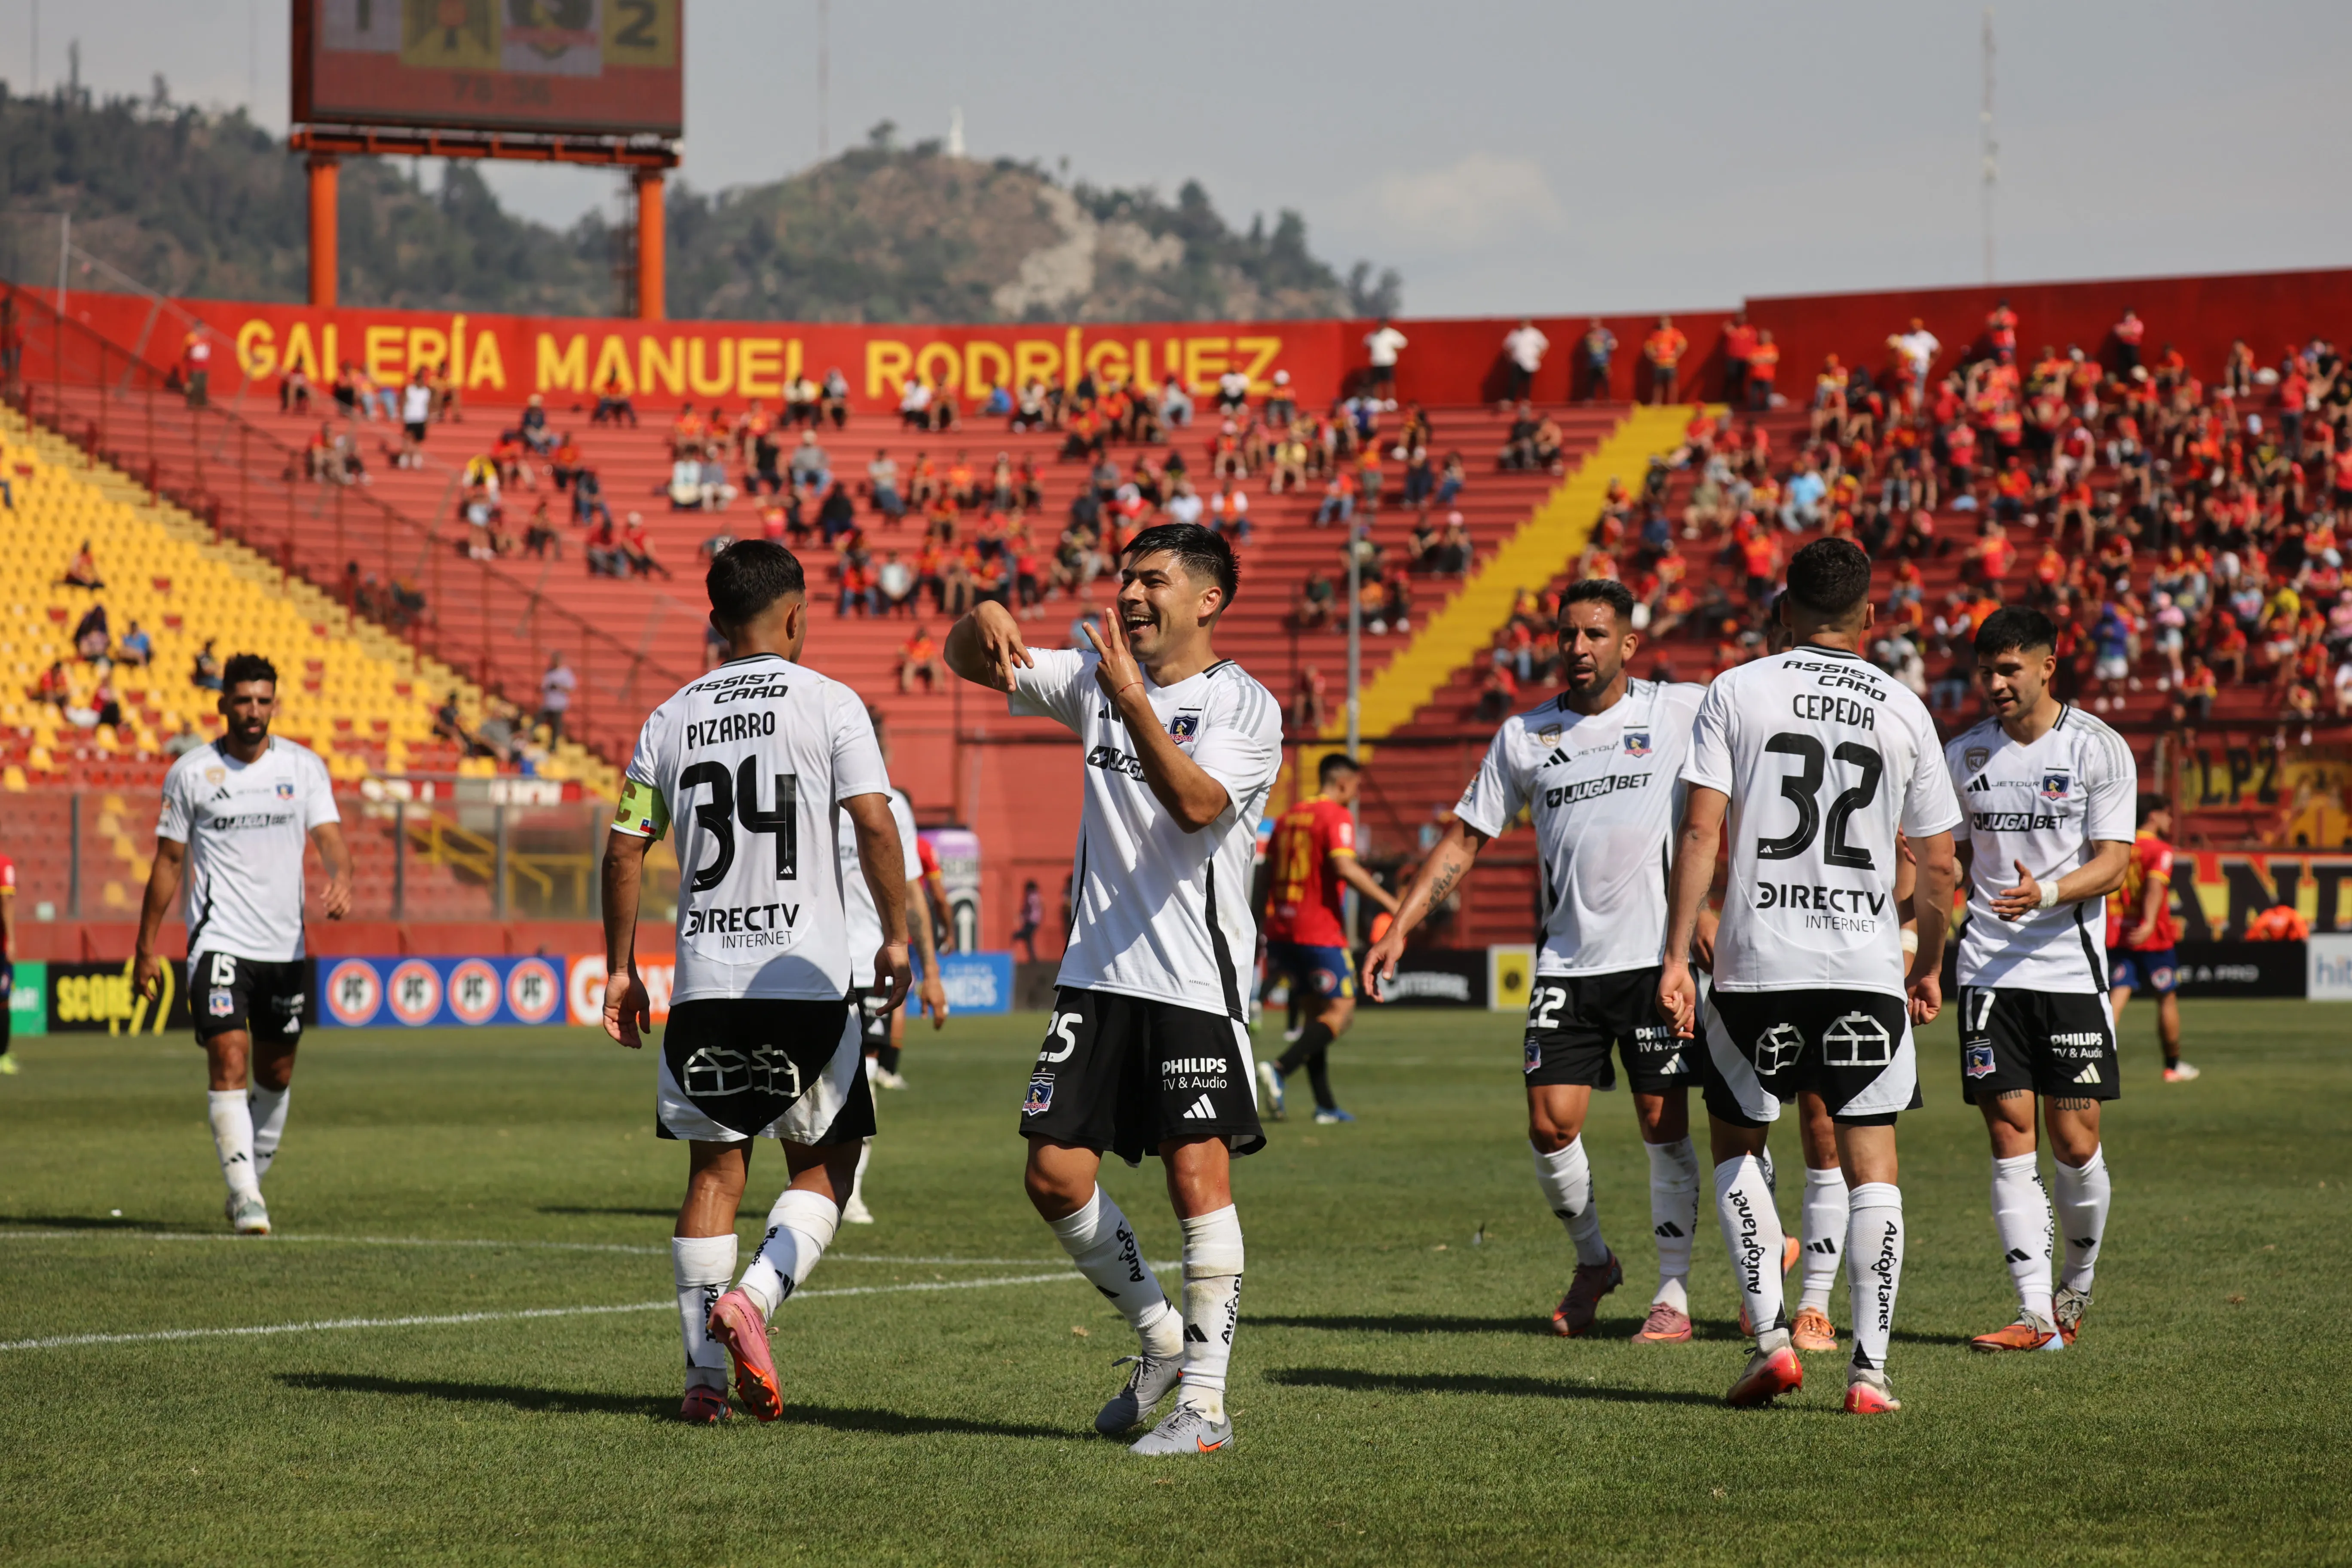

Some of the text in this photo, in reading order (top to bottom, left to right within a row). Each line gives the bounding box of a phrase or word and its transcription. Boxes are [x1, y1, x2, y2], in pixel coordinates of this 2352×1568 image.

[536, 332, 820, 397] MANUEL
[684, 672, 785, 696] ASSIST
[1782, 660, 1882, 684] ASSIST
[714, 685, 788, 704] CARD
[1818, 675, 1887, 702] CARD
[1793, 693, 1874, 731] CEPEDA
[687, 710, 775, 750] PIZARRO
[1110, 750, 1146, 779] JUG
[1757, 732, 1883, 871] 32
[679, 754, 797, 893] 34
[1756, 882, 1886, 916] DIRECTV
[683, 903, 800, 937] DIRECTV
[1806, 915, 1876, 934] INTERNET
[722, 931, 793, 949] INTERNET
[211, 953, 237, 986] 15
[1526, 986, 1566, 1029] 22
[1966, 987, 1996, 1032] 17
[1635, 1026, 1671, 1040] PHIL
[1638, 1041, 1652, 1053] TV
[1654, 1041, 1663, 1051] &
[2050, 1032, 2103, 1046] PHILIPS
[1162, 1058, 1227, 1076] PHILIPS
[2052, 1047, 2103, 1059] TV & Audio
[1162, 1076, 1227, 1091] TV & Audio
[1116, 1220, 1145, 1282] Autop
[1728, 1189, 1766, 1294] Autoplanet
[1871, 1220, 1897, 1333] Autoplanet
